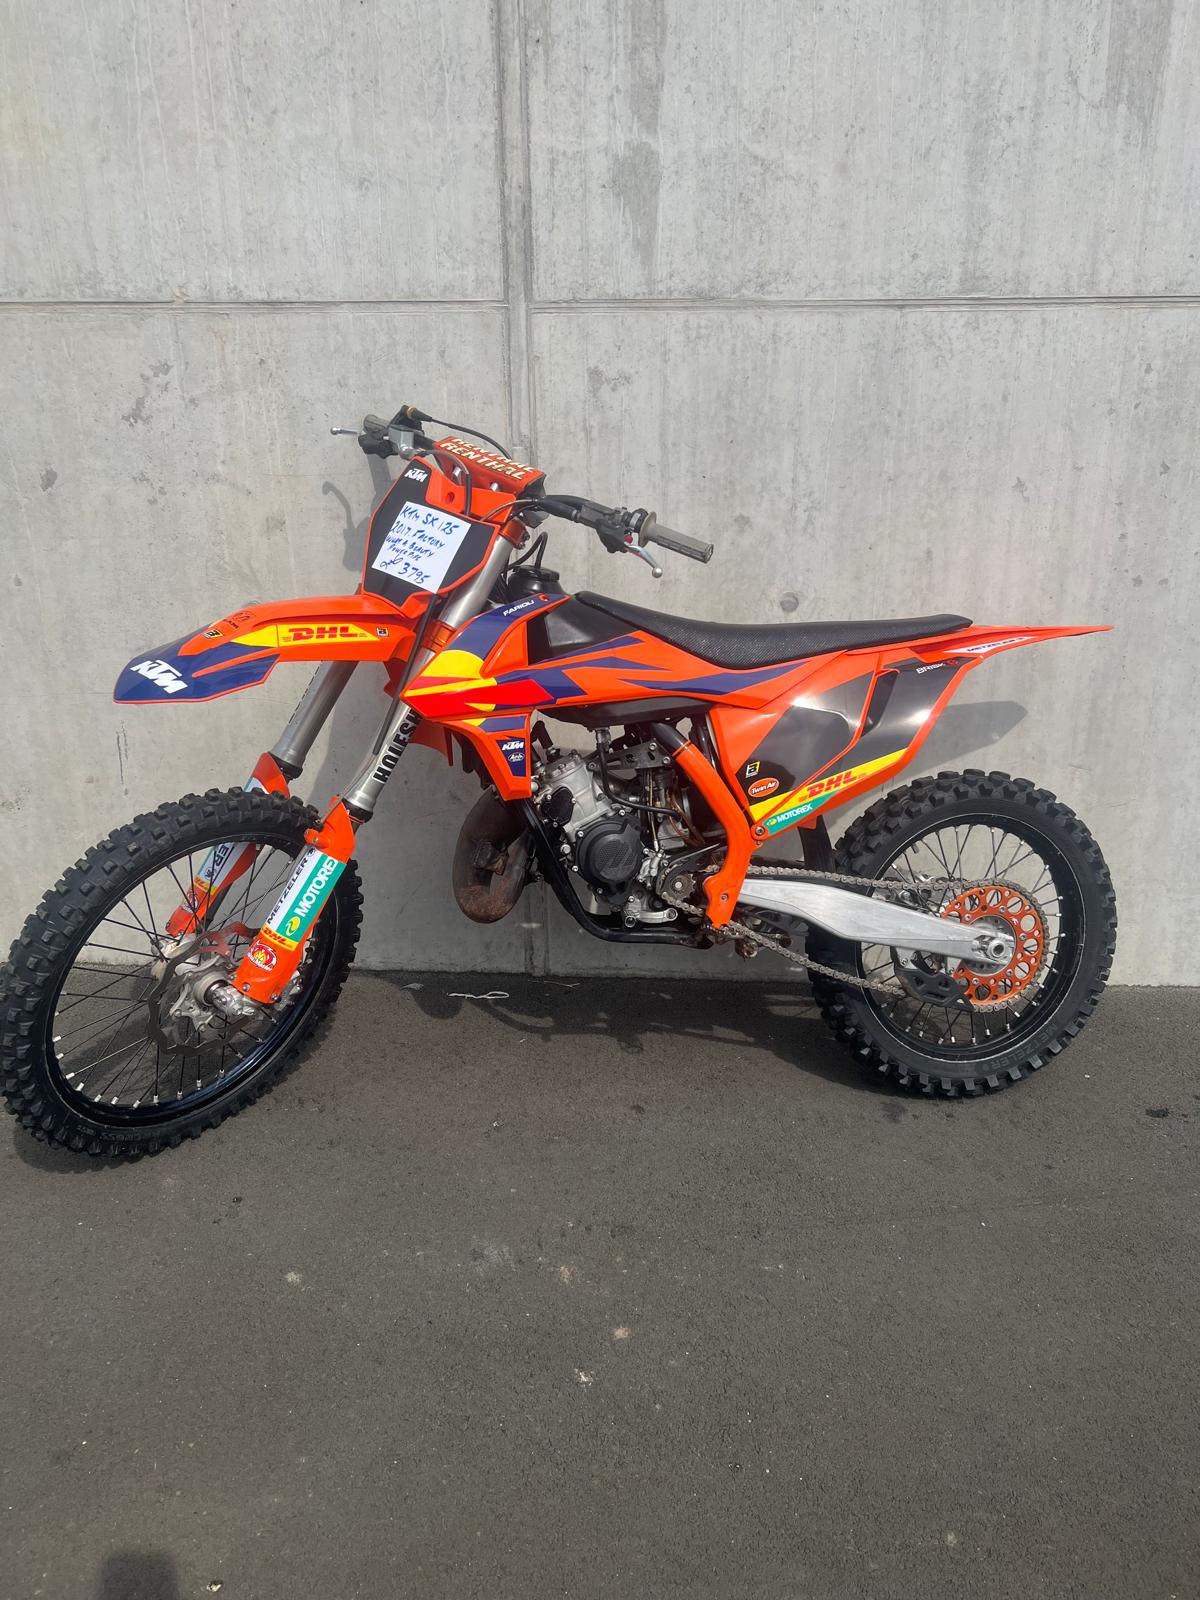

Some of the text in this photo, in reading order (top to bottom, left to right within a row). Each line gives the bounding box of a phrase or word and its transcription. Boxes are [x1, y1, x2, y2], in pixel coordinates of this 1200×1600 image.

[440, 442, 525, 480] RENTHAL
[404, 468, 428, 482] KTM
[422, 513, 439, 526] SX
[438, 520, 460, 535] 125
[288, 626, 358, 641] DHL
[130, 659, 188, 694] KTM
[502, 741, 524, 750] KTM
[751, 780, 777, 794] Twin Air
[807, 771, 856, 798] DHL
[776, 803, 813, 823] MOTOREX
[267, 857, 308, 924] METZELER
